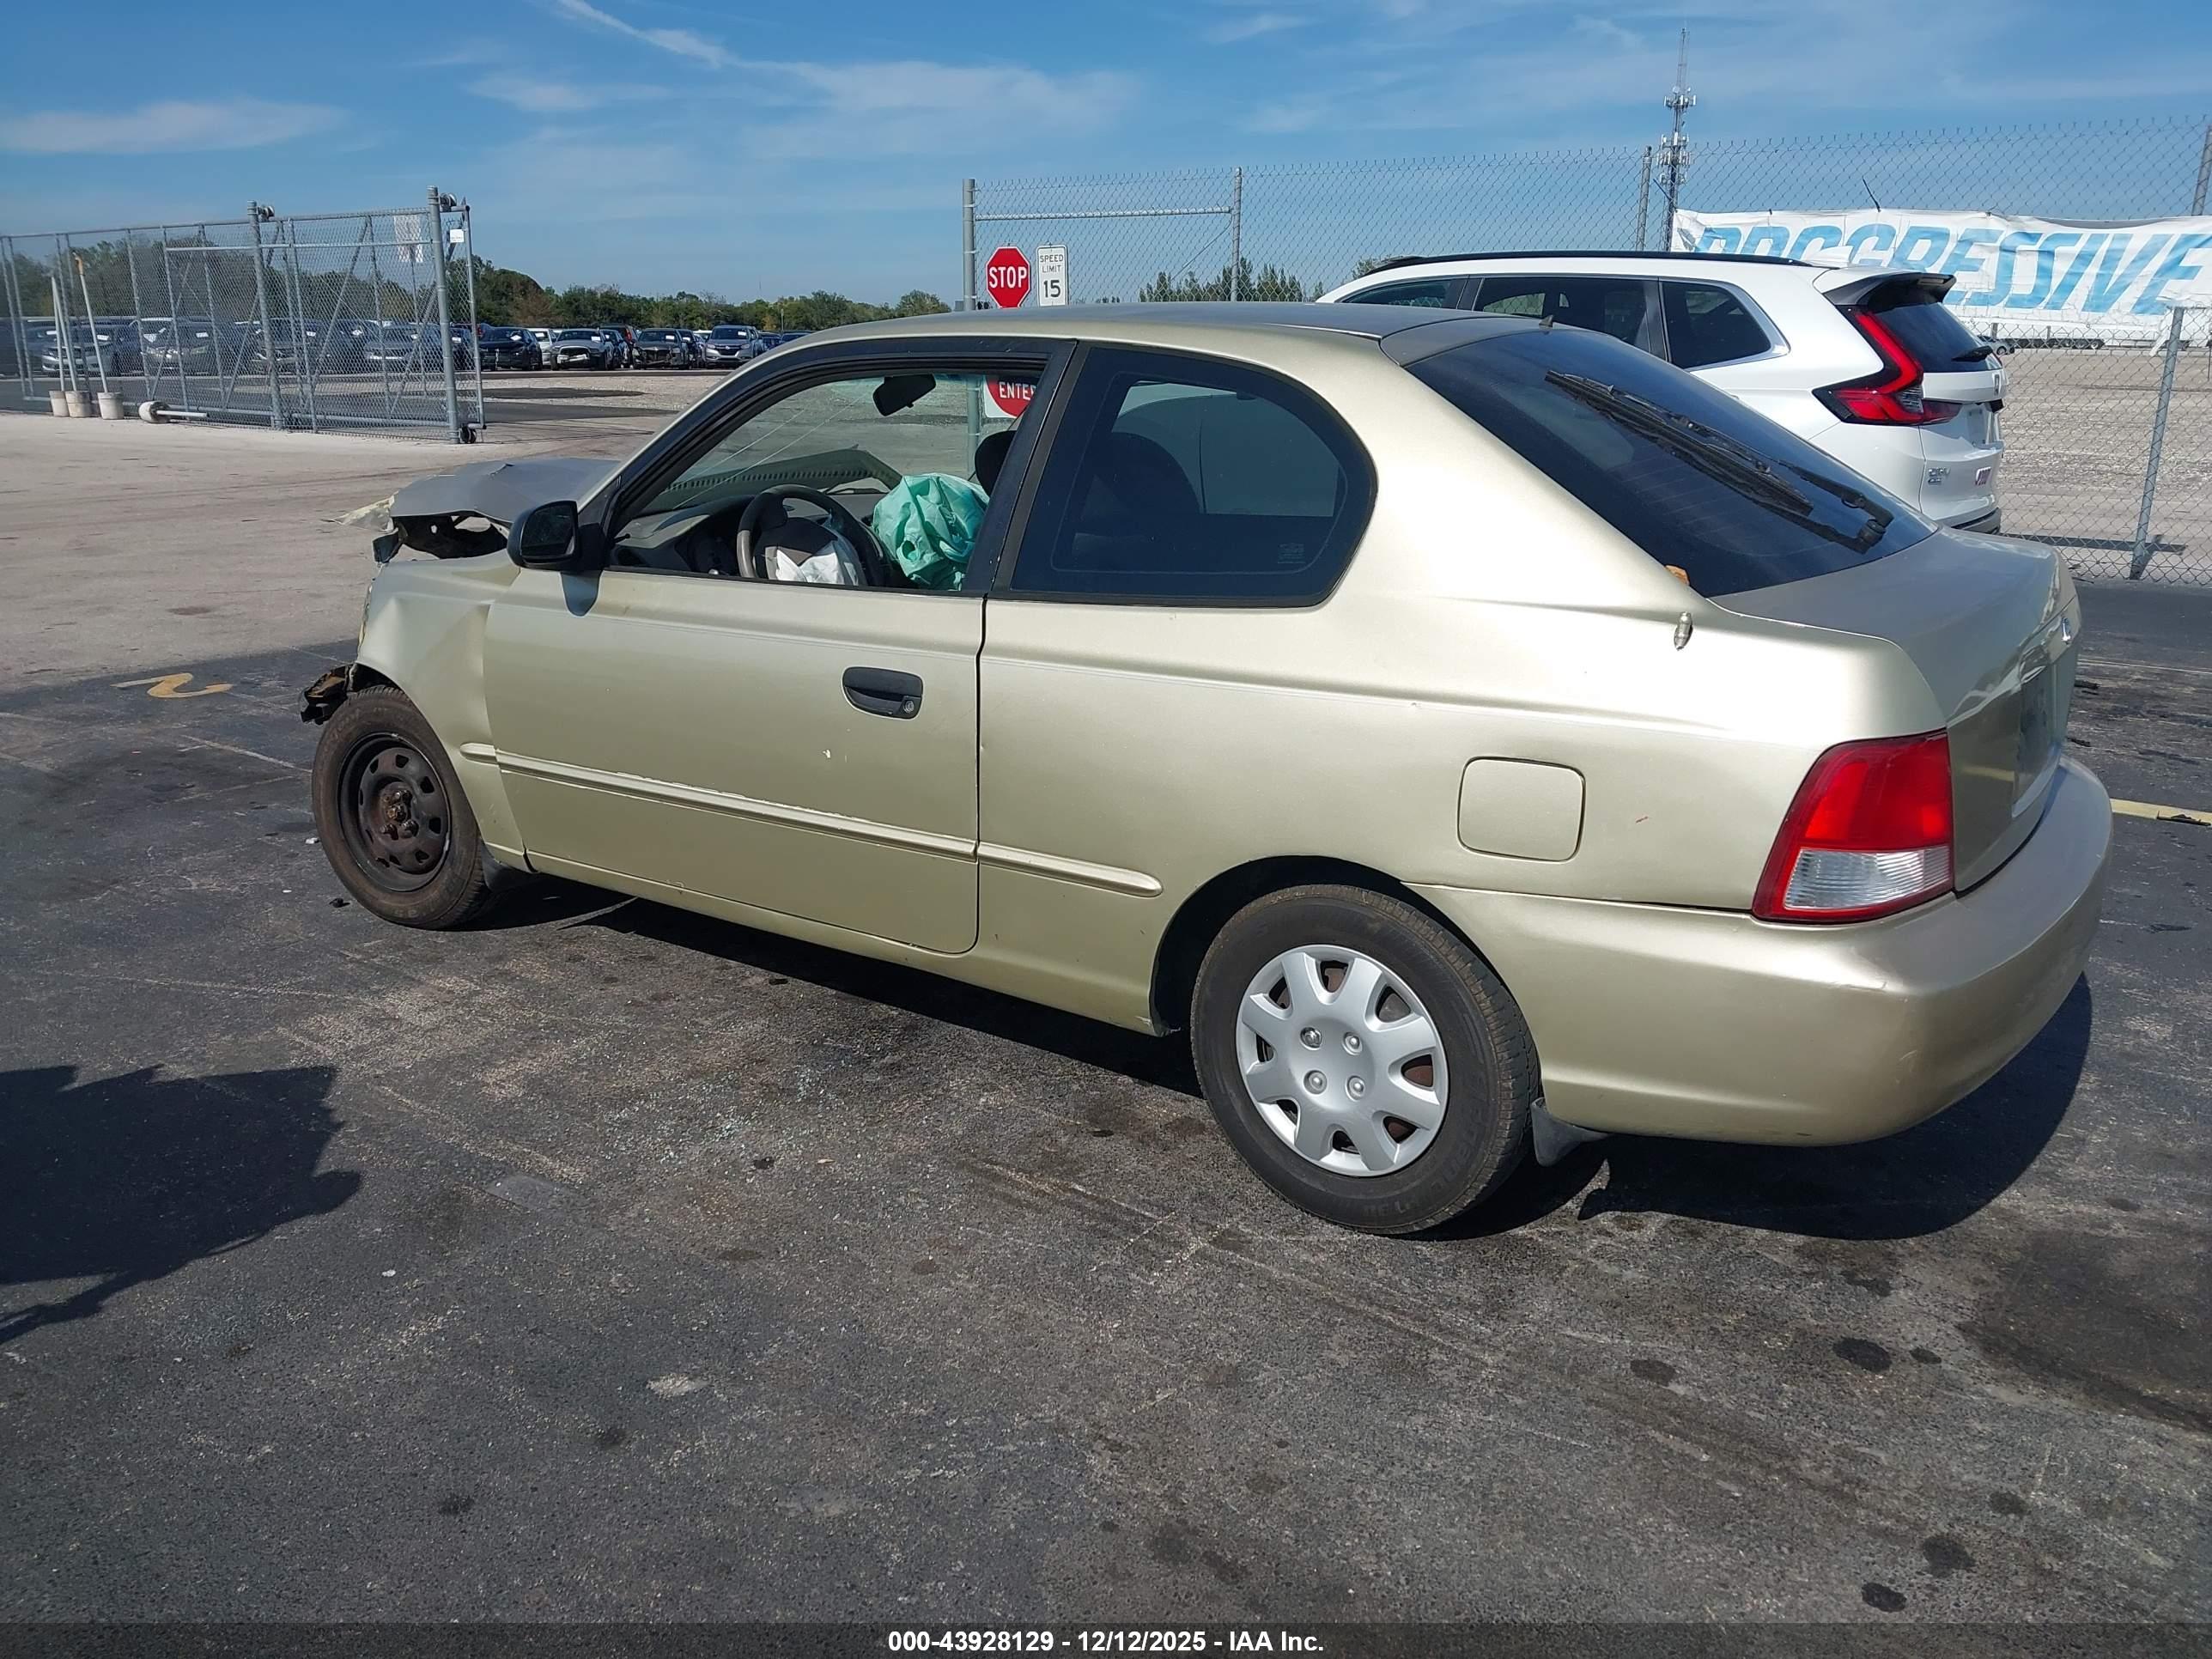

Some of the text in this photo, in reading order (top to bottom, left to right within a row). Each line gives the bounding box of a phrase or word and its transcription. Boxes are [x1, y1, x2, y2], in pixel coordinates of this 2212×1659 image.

[1039, 254, 1064, 263] SPEED
[1042, 264, 1062, 273] LIMIT
[988, 266, 1028, 289] STOP
[1043, 279, 1061, 298] 15
